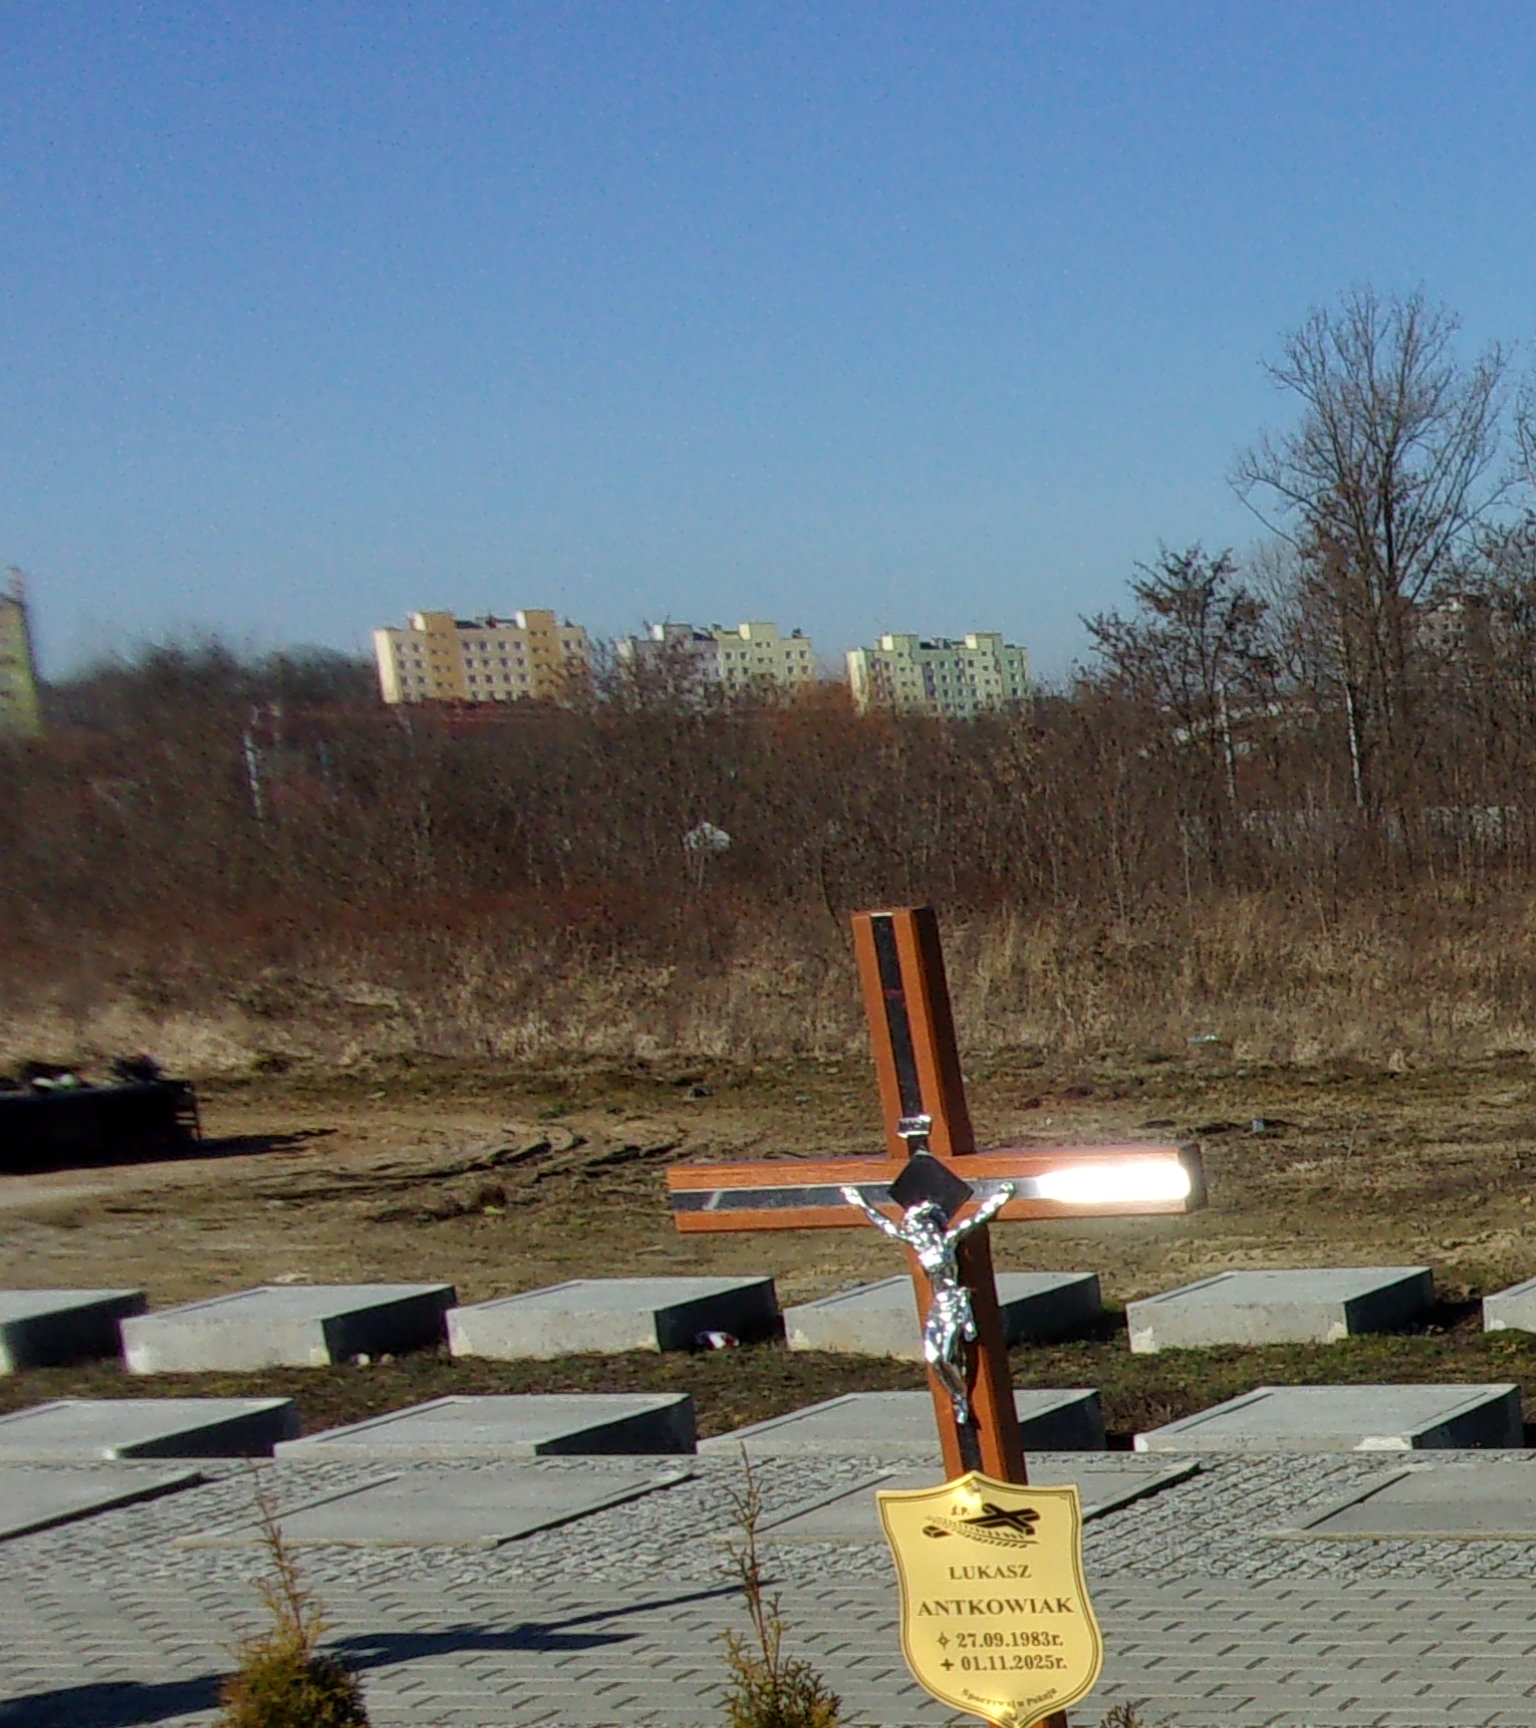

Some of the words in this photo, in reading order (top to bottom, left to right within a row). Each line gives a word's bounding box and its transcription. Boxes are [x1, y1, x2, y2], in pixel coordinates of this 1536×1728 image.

[917, 1596, 1075, 1617] ANTKOWIAK
[956, 1631, 1064, 1649] 27.09.1983r.
[961, 1654, 1068, 1672] 01.11.2025r.
